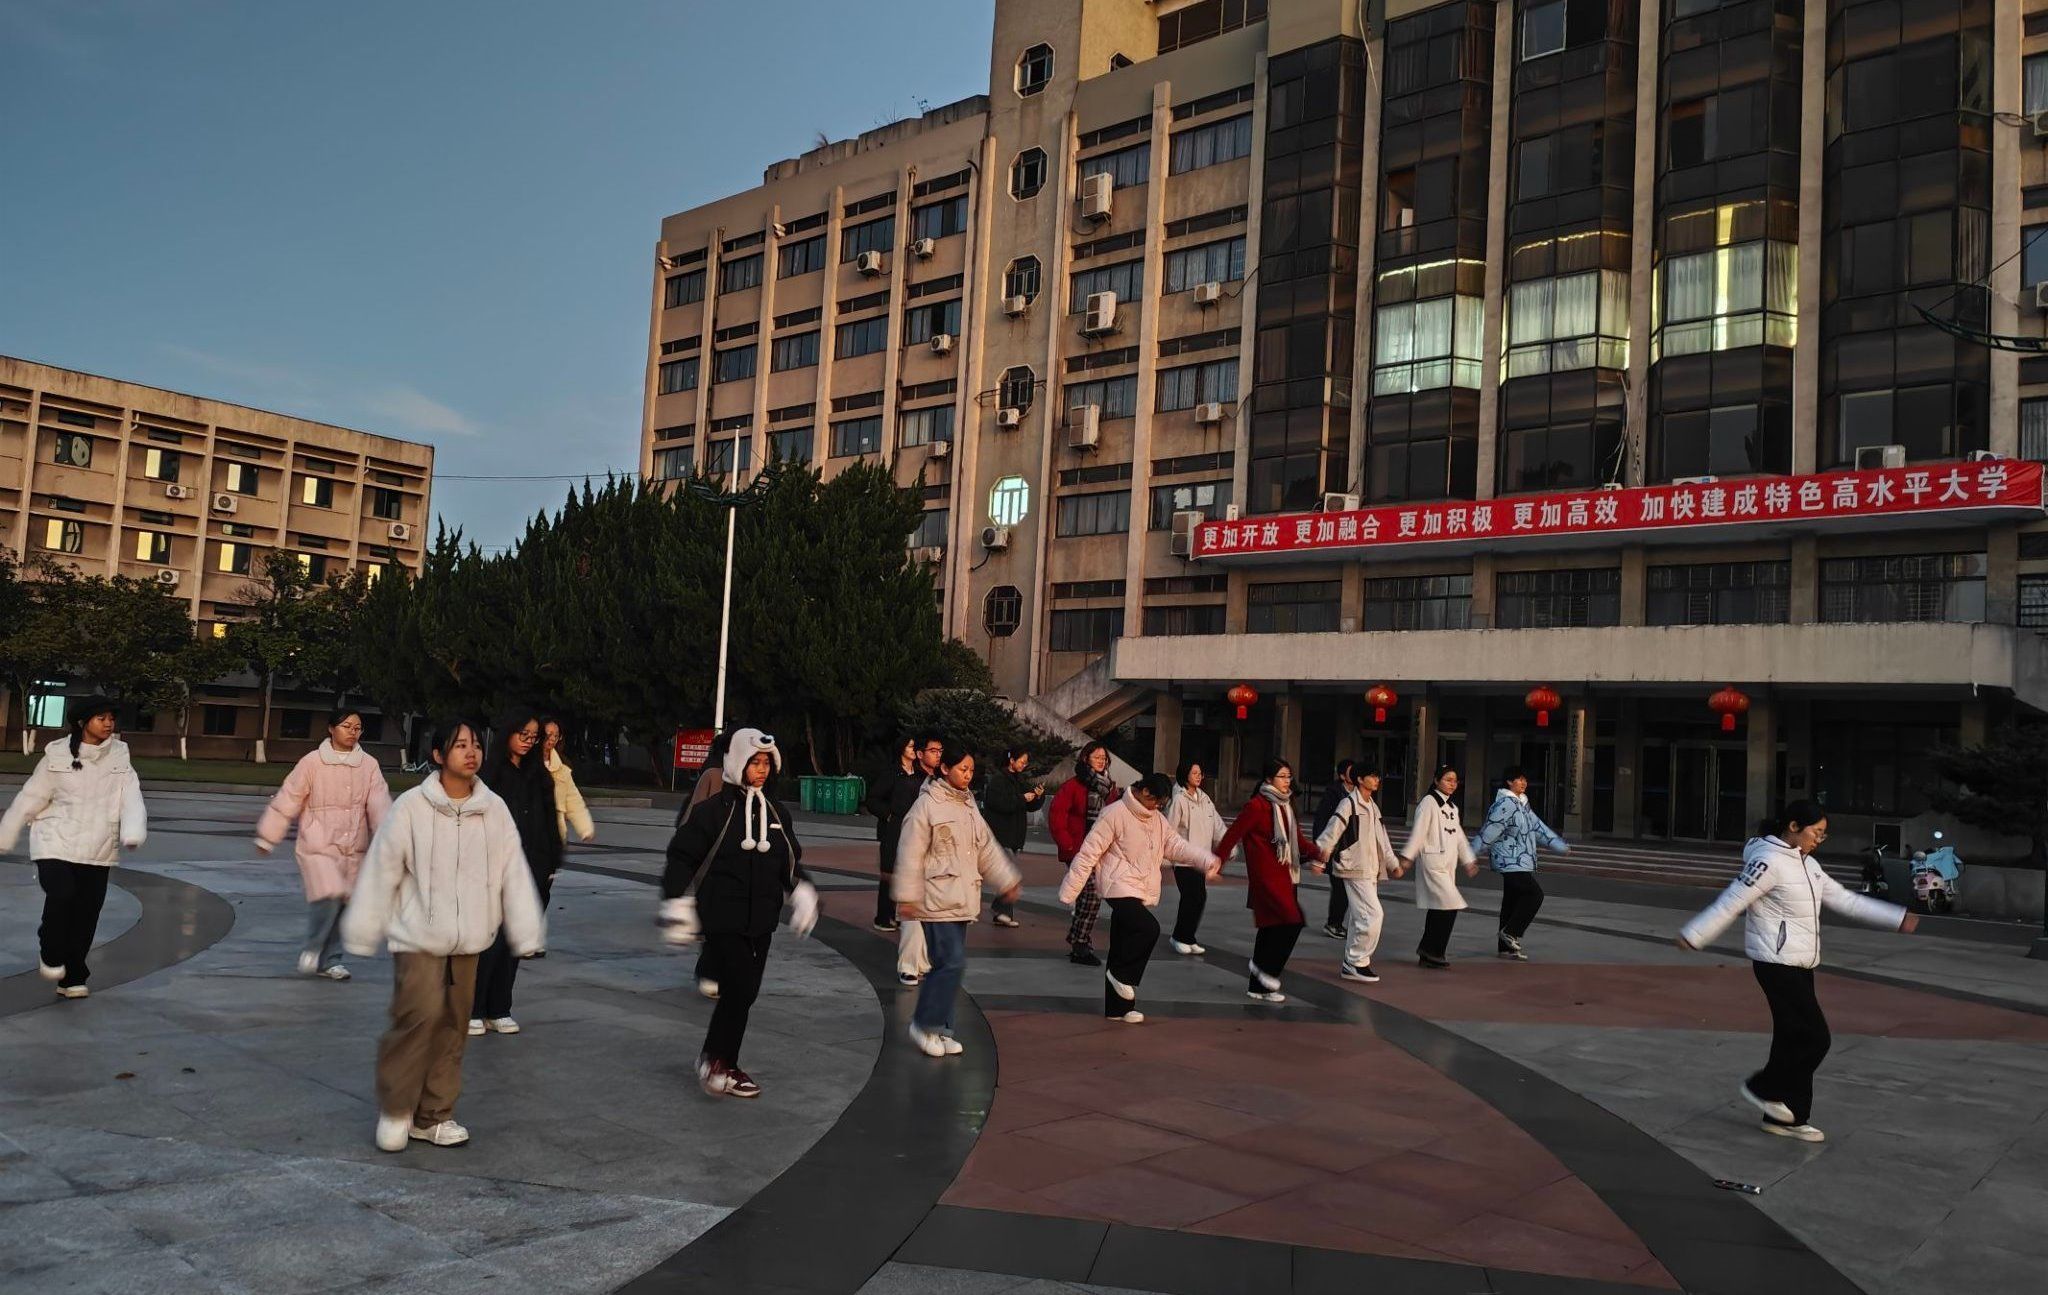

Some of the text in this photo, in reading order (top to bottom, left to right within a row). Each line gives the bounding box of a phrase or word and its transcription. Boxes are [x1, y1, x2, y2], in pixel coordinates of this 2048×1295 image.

[1202, 465, 2008, 550] 更加开放 更加融合 更加积极 更加高效 加快建成特色高水平大学
